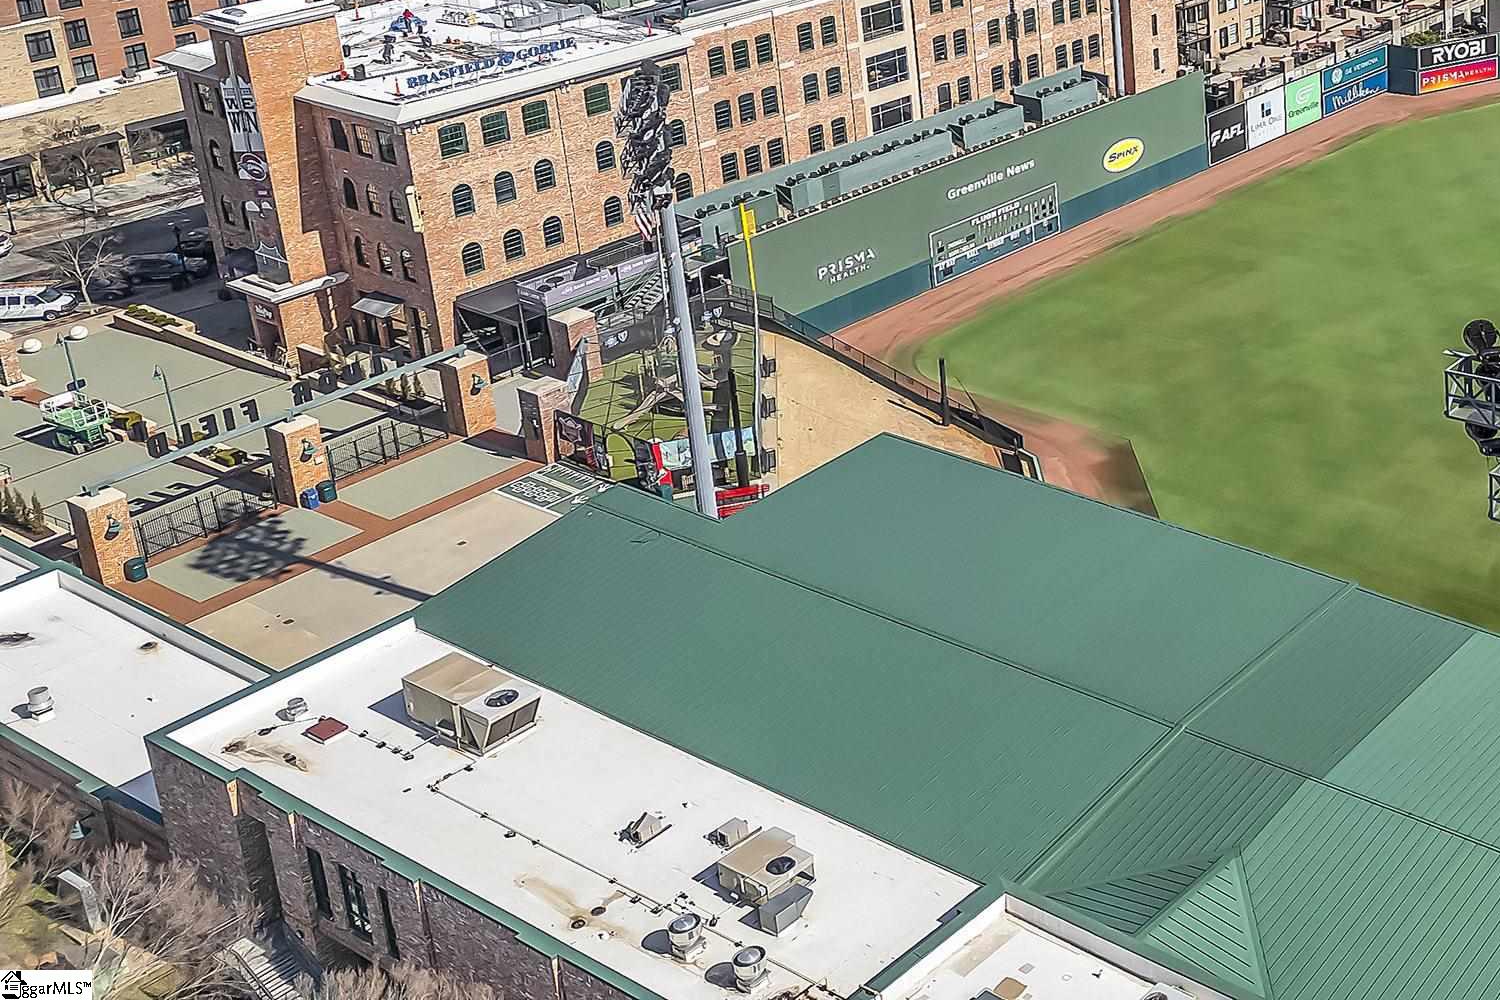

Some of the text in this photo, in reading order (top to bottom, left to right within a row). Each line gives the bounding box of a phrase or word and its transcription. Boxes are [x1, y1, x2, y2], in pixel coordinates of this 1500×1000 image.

[405, 37, 578, 88] BRASFIELD & GORRIE
[1431, 39, 1487, 64] RYOBI
[1422, 71, 1465, 87] PRISMA
[224, 96, 256, 110] WE
[1332, 79, 1382, 111] Milliken
[1287, 101, 1319, 118] Greenville
[228, 111, 260, 134] WIN
[946, 159, 1035, 200] Greenville News
[817, 248, 876, 280] PRISMA
